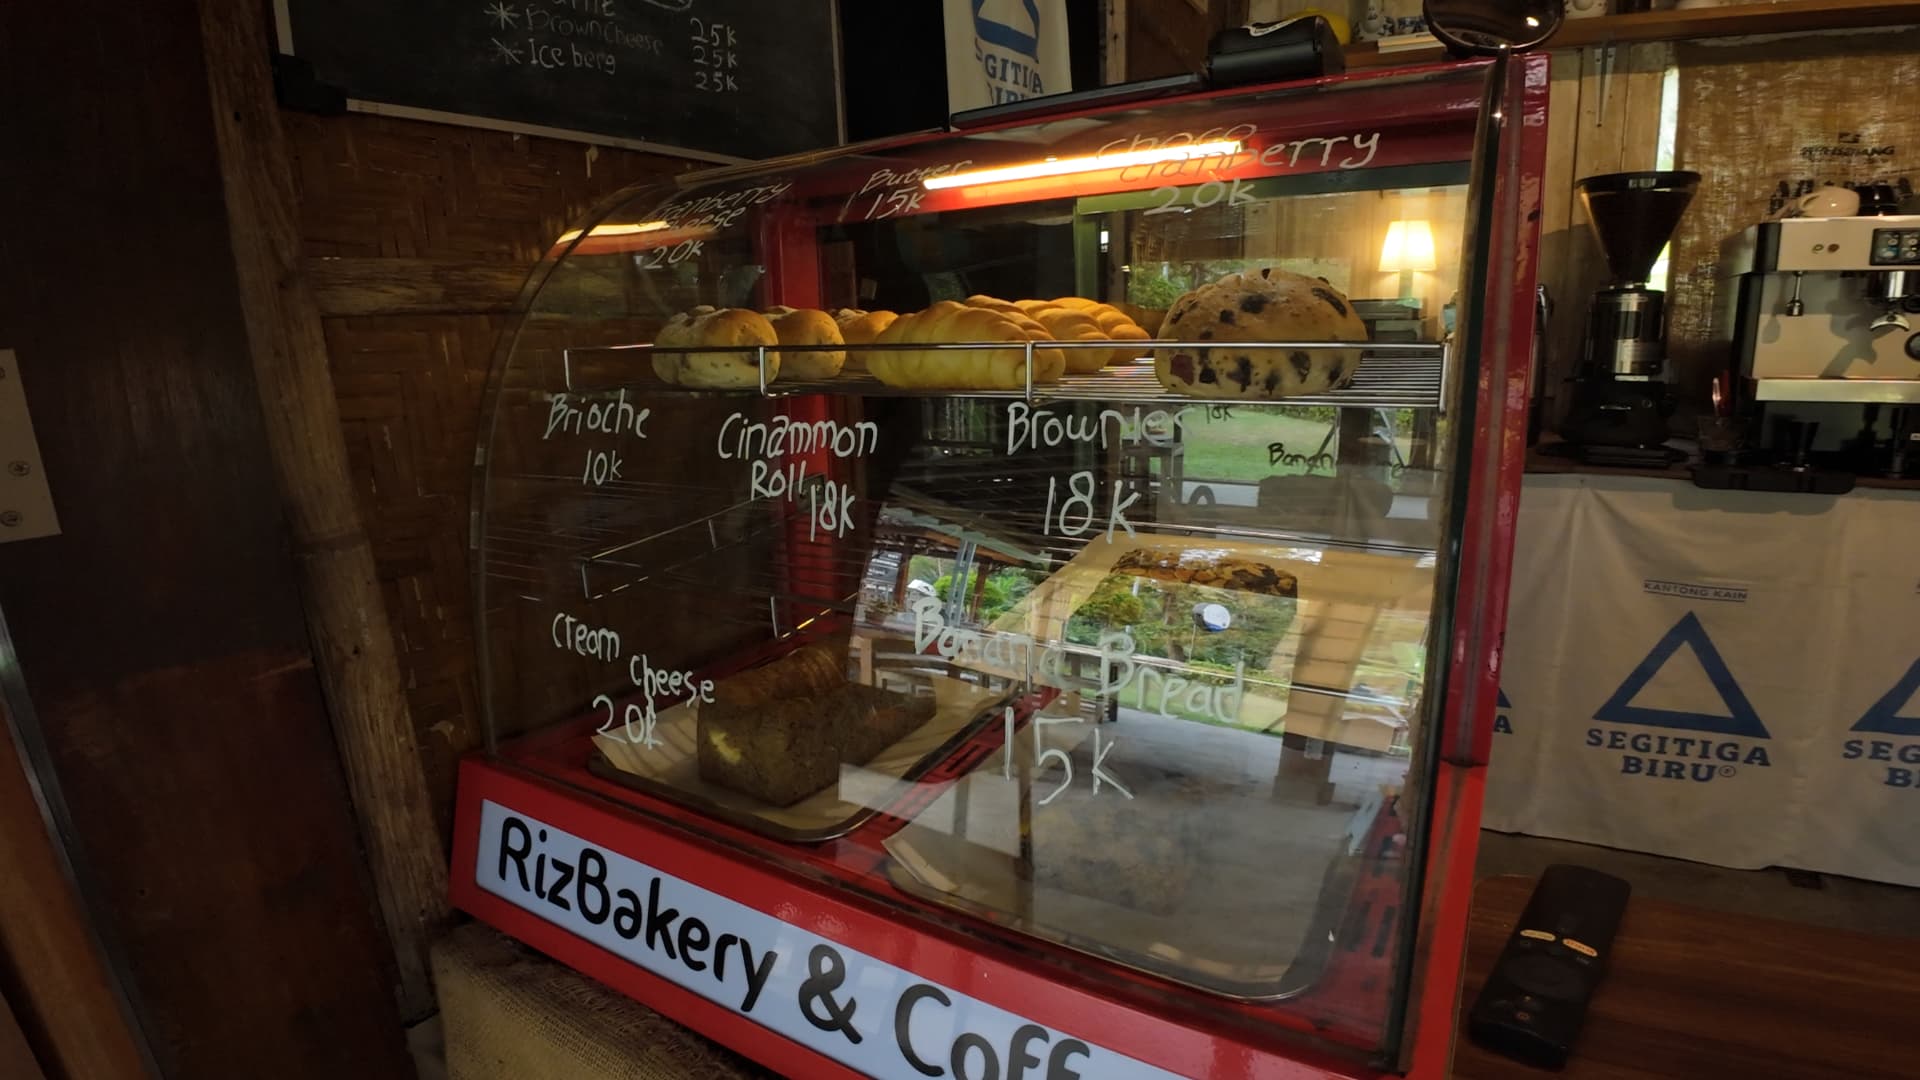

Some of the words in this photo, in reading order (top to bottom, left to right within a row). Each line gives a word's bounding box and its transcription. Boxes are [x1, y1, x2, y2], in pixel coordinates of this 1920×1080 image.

[543, 388, 651, 441] Brioche
[717, 412, 879, 460] Cinammon
[1643, 582, 1709, 597] KANTONG
[1712, 589, 1748, 600] KAIN
[1099, 630, 1245, 724] Bread
[1585, 728, 1772, 767] SEGITIGA
[498, 816, 779, 1013] RizBakery
[797, 943, 865, 1046] &
